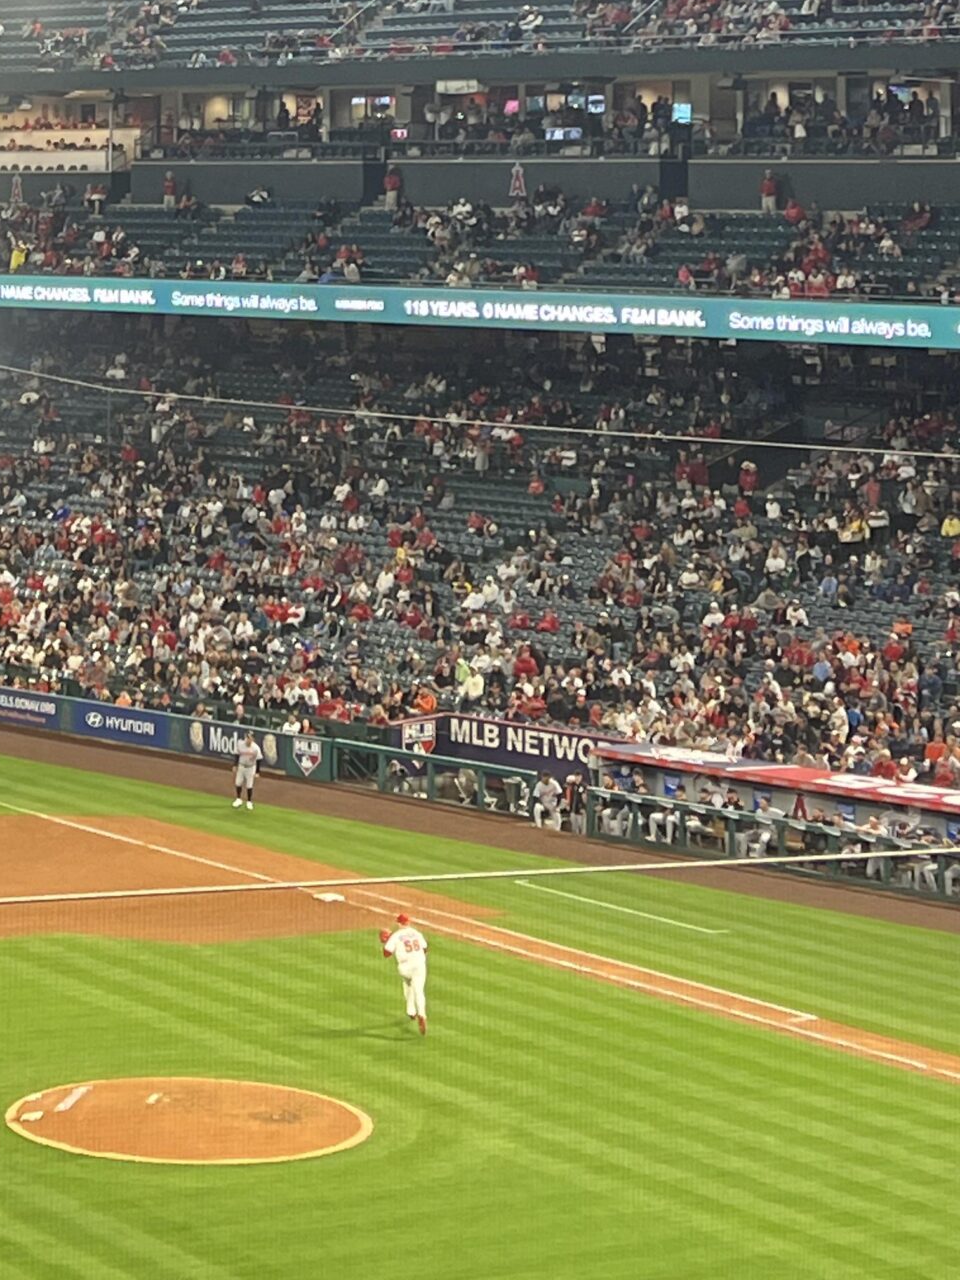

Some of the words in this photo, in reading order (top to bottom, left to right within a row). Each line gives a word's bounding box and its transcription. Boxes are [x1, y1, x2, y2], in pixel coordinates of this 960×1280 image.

[0, 285, 33, 300] NAME
[171, 291, 205, 307] Some
[206, 293, 240, 311] things
[241, 295, 258, 309] will
[259, 295, 298, 313] always
[429, 300, 480, 318] YEARS.
[494, 303, 539, 321] NAME
[539, 304, 618, 323] CHANGES.
[656, 309, 706, 328] BANK.
[729, 311, 775, 330] Some
[775, 315, 825, 336] things
[825, 317, 850, 334] will
[850, 318, 905, 339] always
[906, 319, 932, 338] be.
[105, 715, 155, 736] HYUNDAI
[209, 725, 239, 755] Mod
[450, 718, 500, 749] MLB
[506, 727, 611, 764] NETWO
